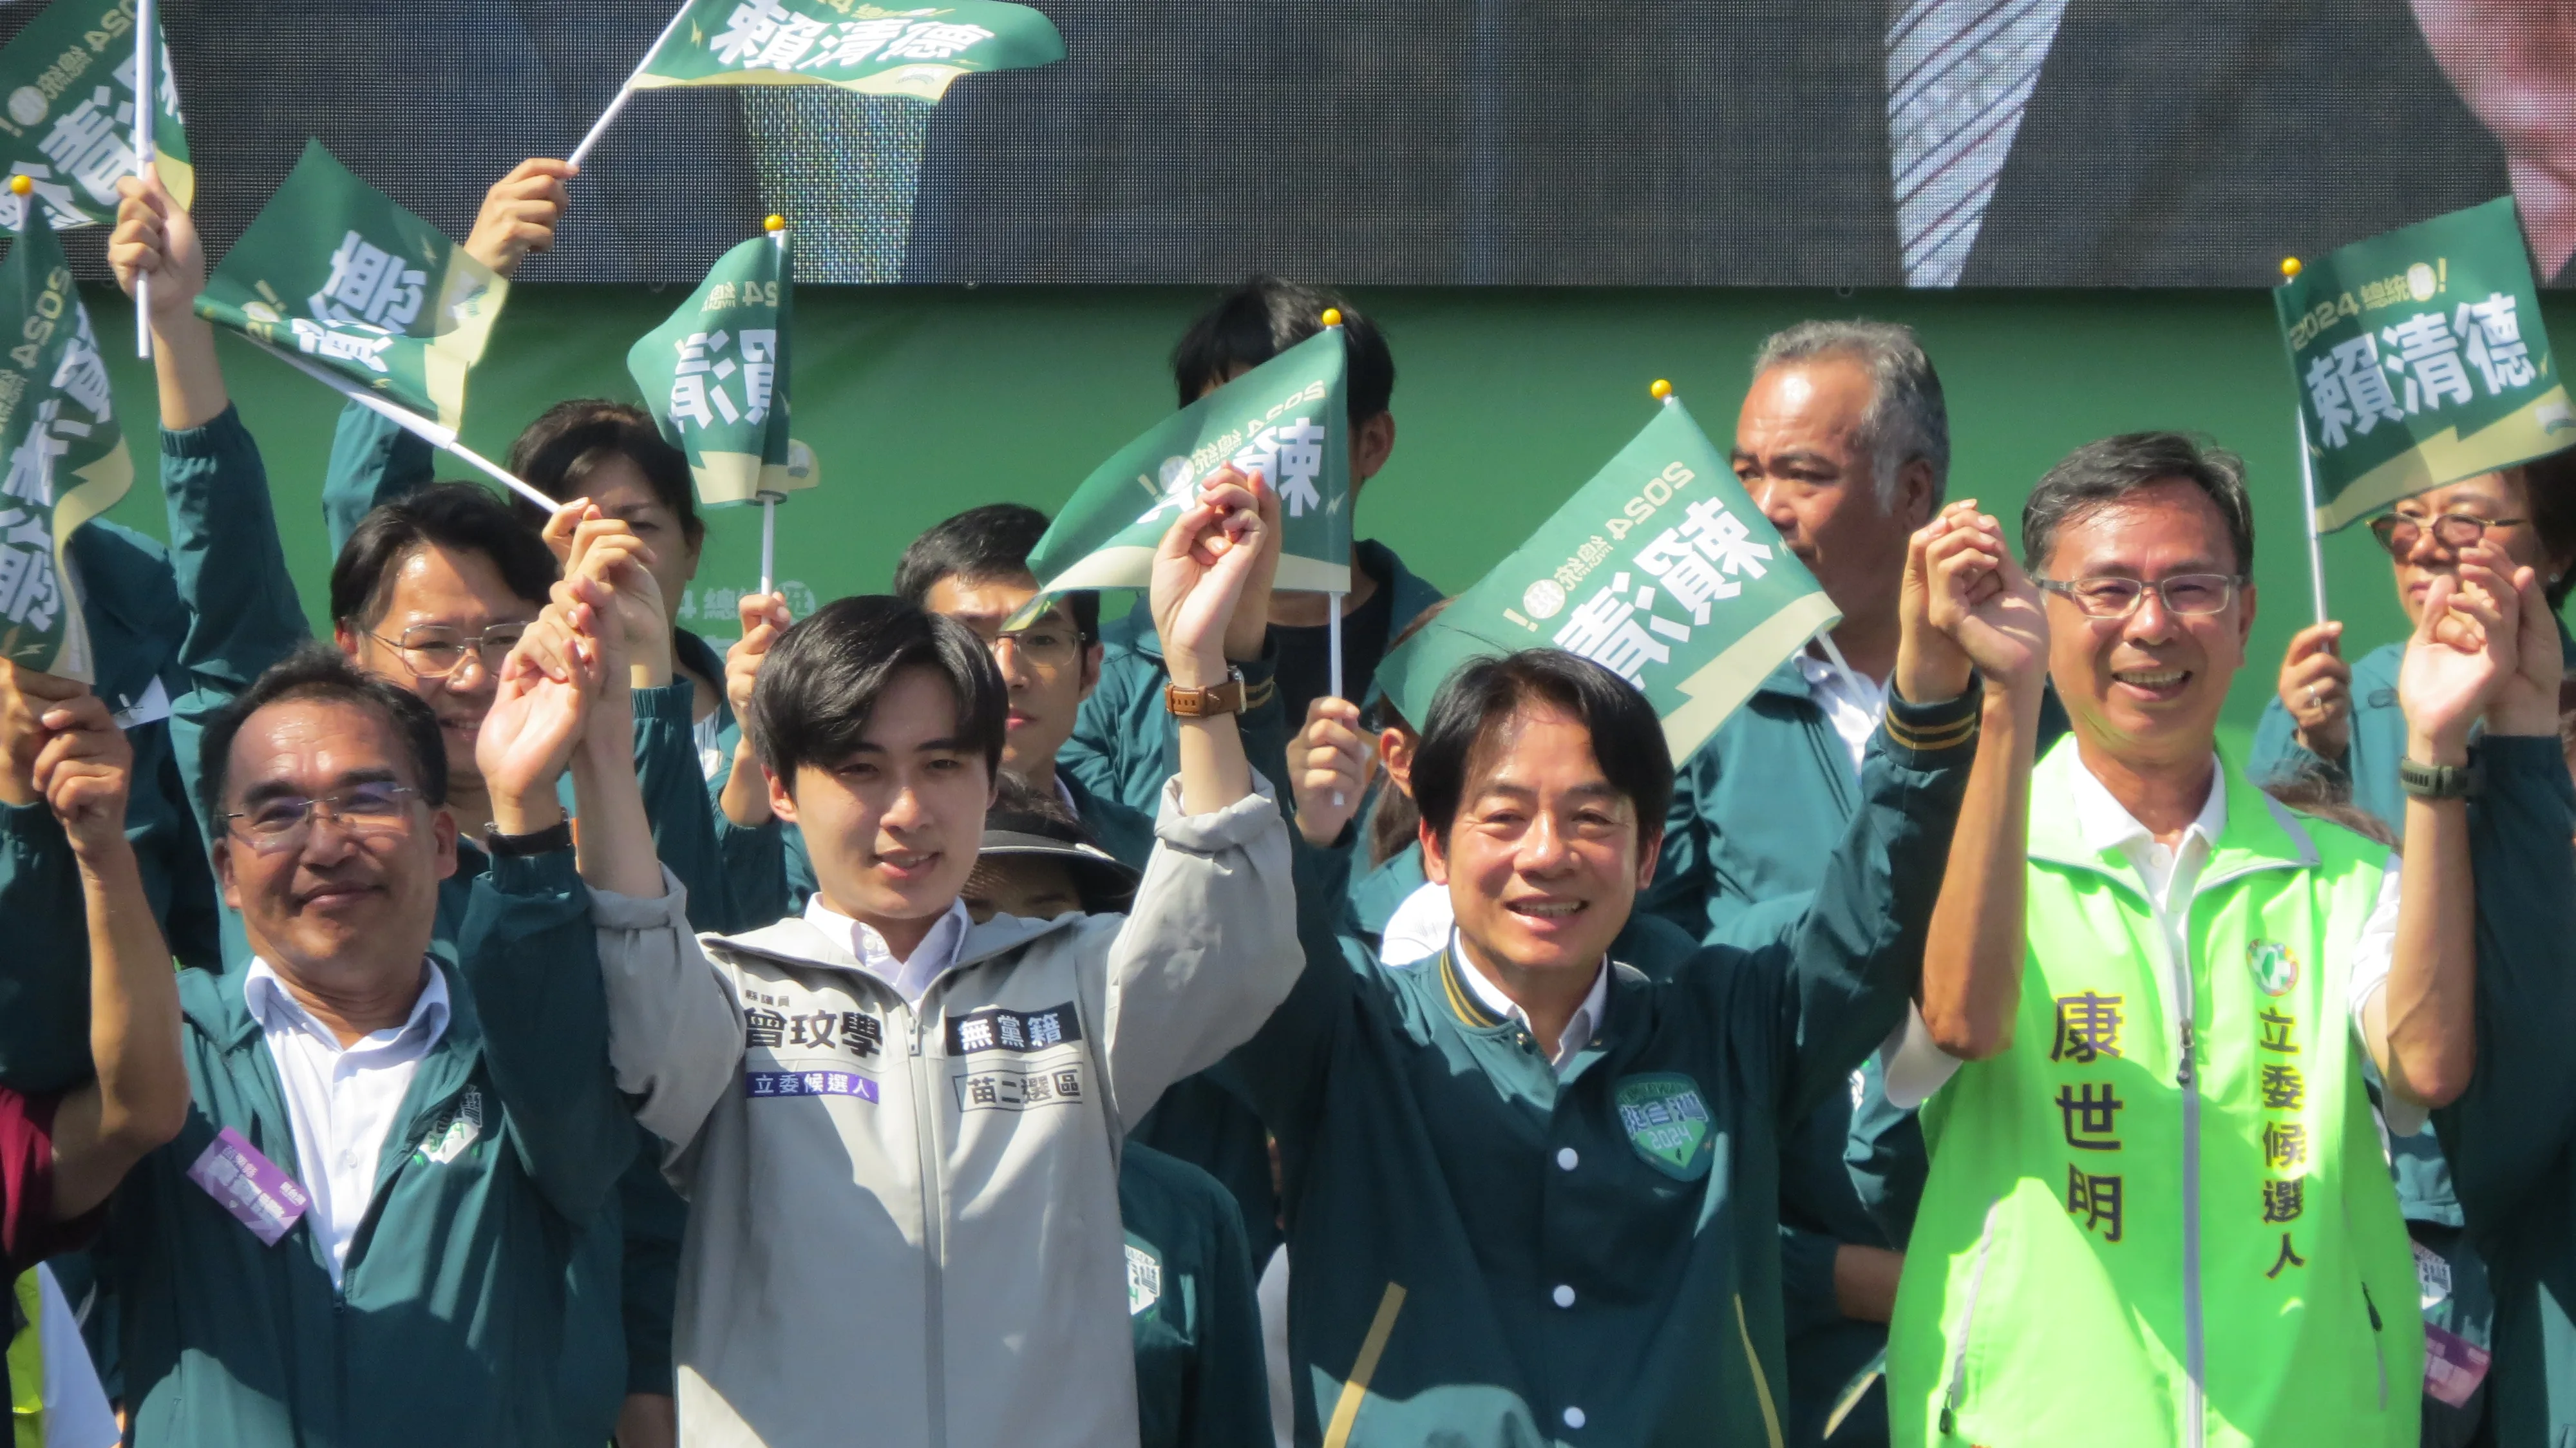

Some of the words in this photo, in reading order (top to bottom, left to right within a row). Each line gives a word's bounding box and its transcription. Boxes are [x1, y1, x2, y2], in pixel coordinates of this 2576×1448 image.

[710, 0, 996, 71] 賴清德
[2289, 292, 2360, 351] 2024
[2306, 292, 2536, 450] 賴清德
[744, 1007, 883, 1058] 曾玟學
[958, 1013, 1062, 1051] 無黨籍
[754, 1073, 870, 1099] 立委候選人
[967, 1069, 1081, 1105] 苗二選區
[1647, 1125, 1693, 1150] 2024
[2050, 991, 2124, 1243] 康世明
[2259, 1007, 2306, 1279] 立委候選人
